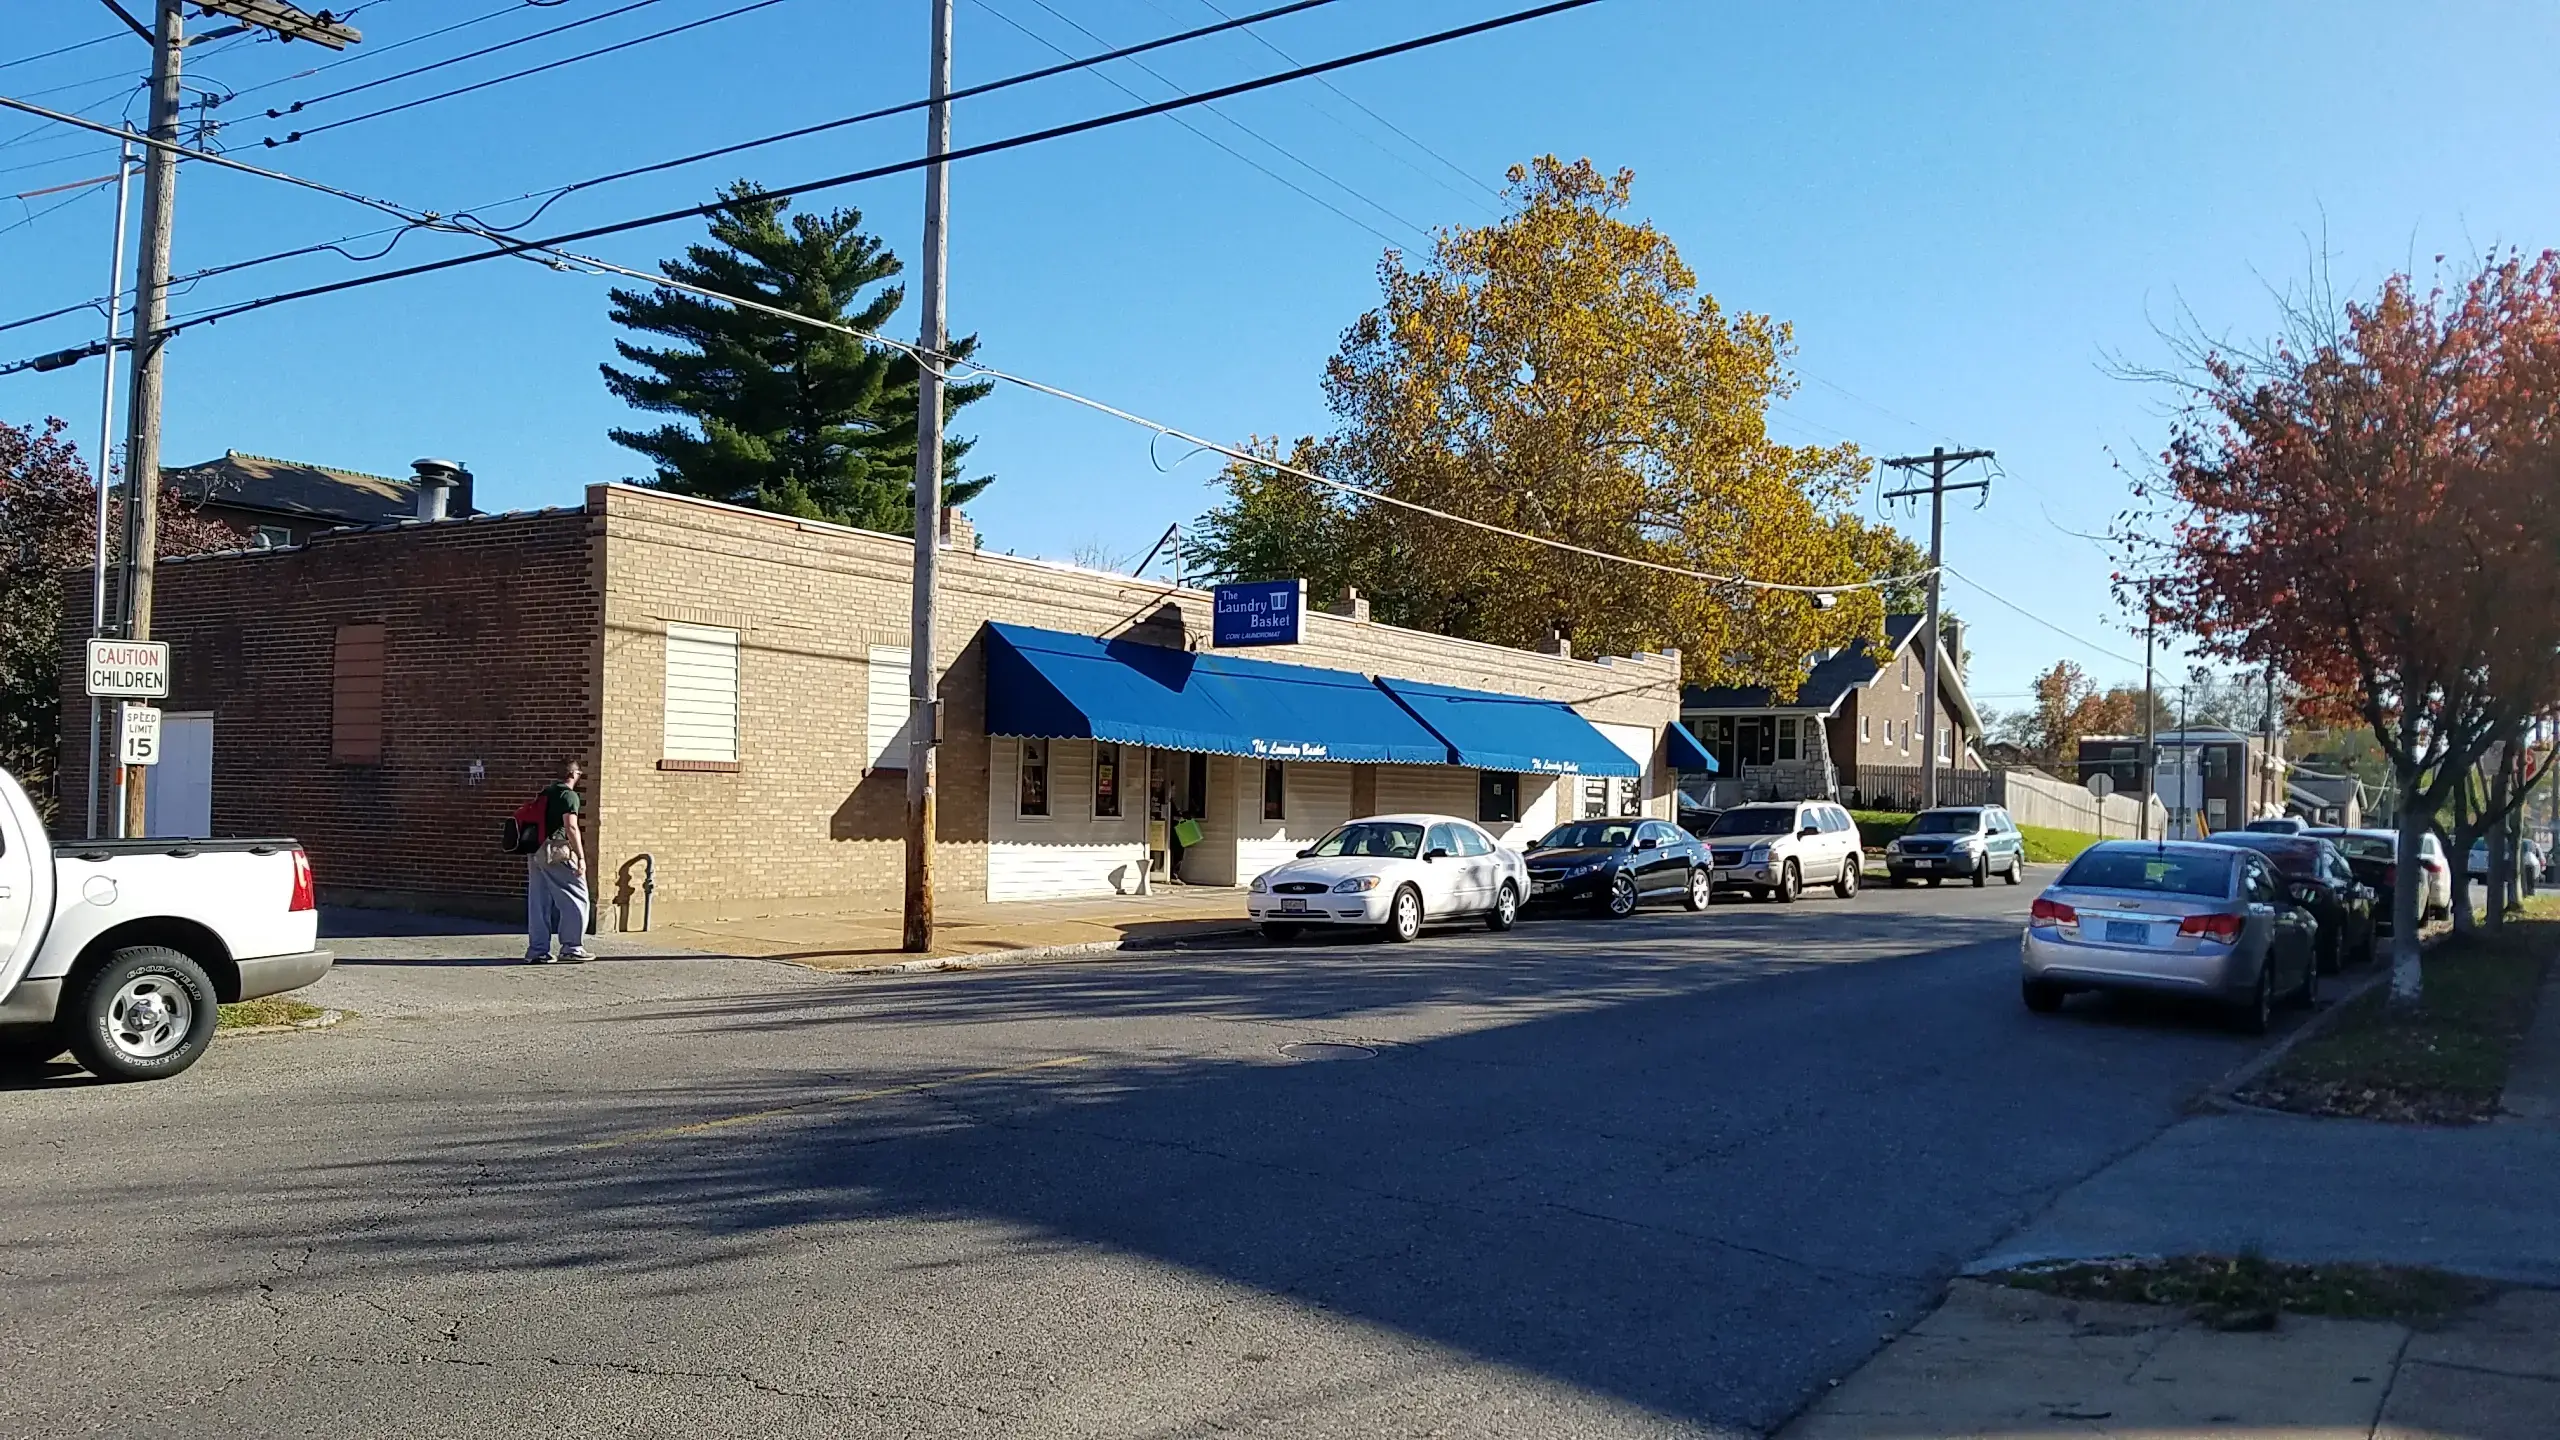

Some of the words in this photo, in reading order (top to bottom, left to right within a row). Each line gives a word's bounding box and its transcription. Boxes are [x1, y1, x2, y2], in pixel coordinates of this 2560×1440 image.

[1222, 590, 1239, 600] The
[1218, 598, 1267, 614] Laundry
[1250, 613, 1290, 628] Basket
[1225, 632, 1240, 640] COIN
[97, 647, 159, 666] CAUTION
[92, 670, 163, 689] CHILDREN
[126, 712, 157, 723] SPEED
[128, 725, 153, 734] LIMIT
[128, 737, 152, 757] 15
[126, 965, 202, 1001] GOODYEAR
